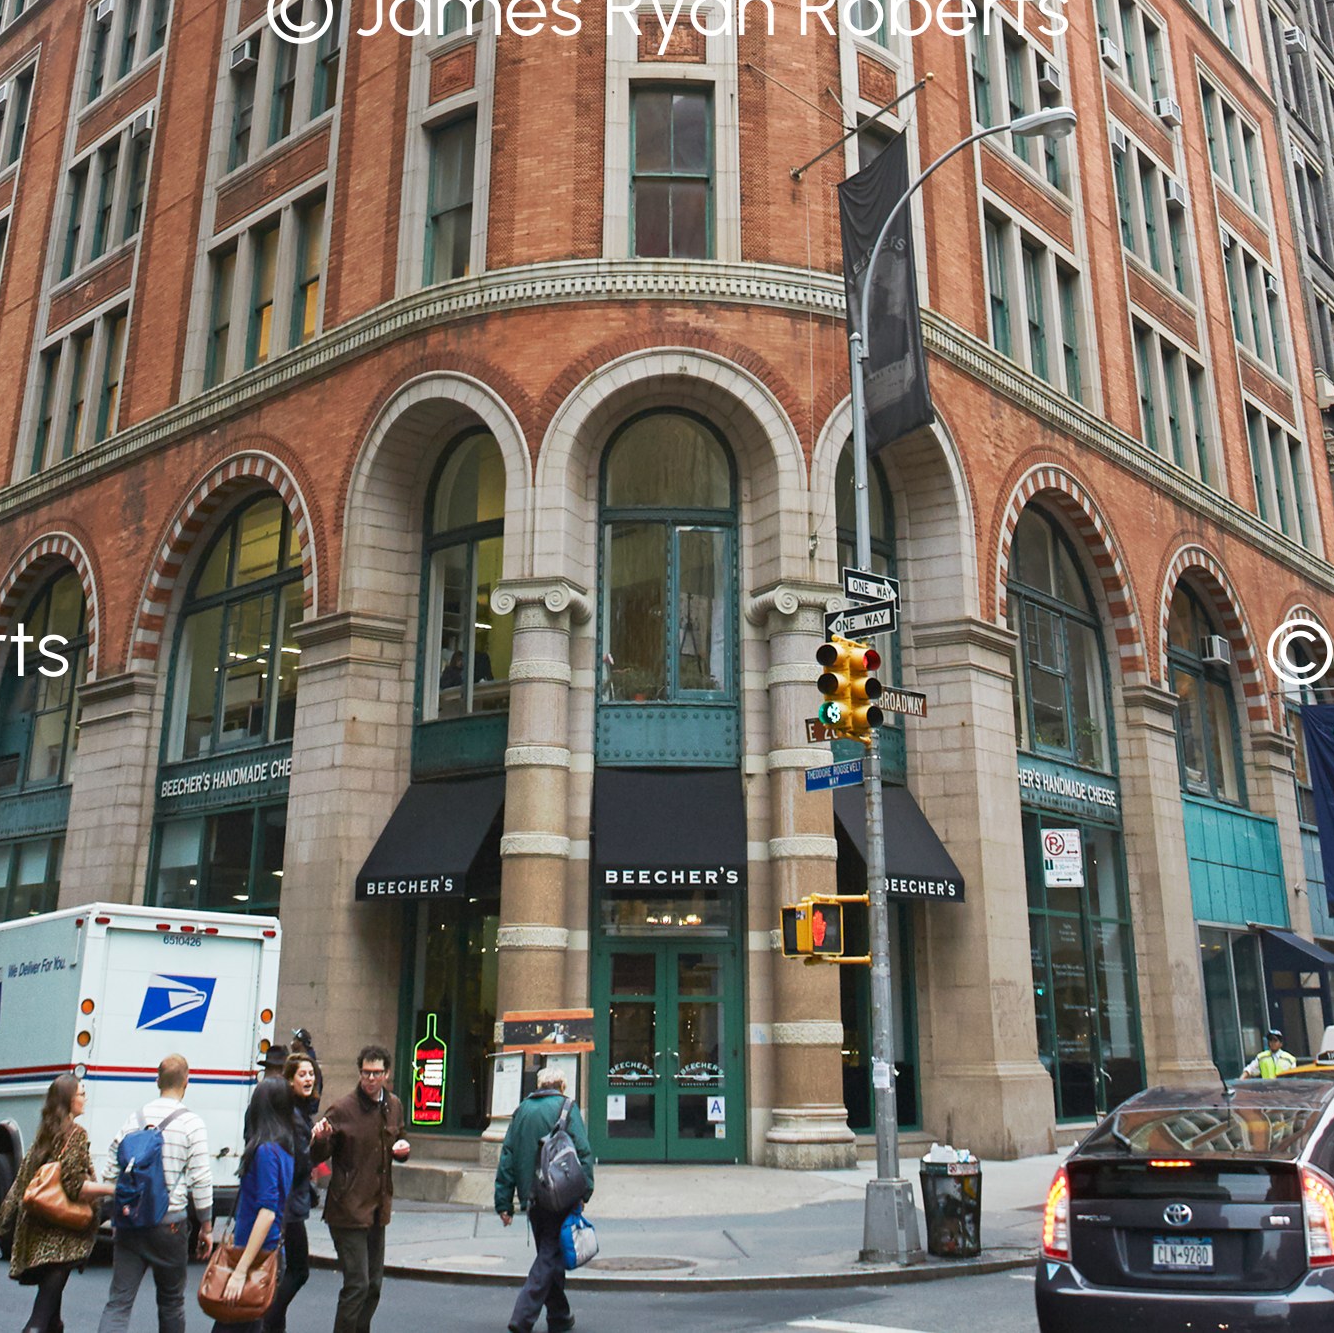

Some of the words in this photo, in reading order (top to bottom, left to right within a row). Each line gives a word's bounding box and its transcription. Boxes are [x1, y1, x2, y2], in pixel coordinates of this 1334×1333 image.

[852, 579, 870, 595] ONE
[875, 583, 892, 600] WAY
[835, 617, 856, 633] ONE
[864, 610, 886, 626] WAY
[878, 691, 924, 716] BROADWAY
[809, 723, 817, 742] E
[833, 761, 861, 775] ROOSEVELT
[161, 772, 210, 798] BEECHER'S
[212, 762, 268, 789] HANDMADE
[829, 776, 839, 786] WAY
[1042, 773, 1087, 802] HANDMADE
[1087, 785, 1117, 807] CHEESE
[366, 875, 453, 895] BEECHER'S
[605, 866, 739, 885] BEECHER'S
[883, 878, 956, 897] BEECHER'S
[163, 935, 201, 947] 6510426
[8, 965, 18, 979] We
[18, 960, 41, 977] Deliver
[41, 959, 52, 973] For
[610, 1061, 654, 1075] BEECHER'S
[680, 1061, 724, 1075] BEECHER'S
[710, 1099, 722, 1114] A
